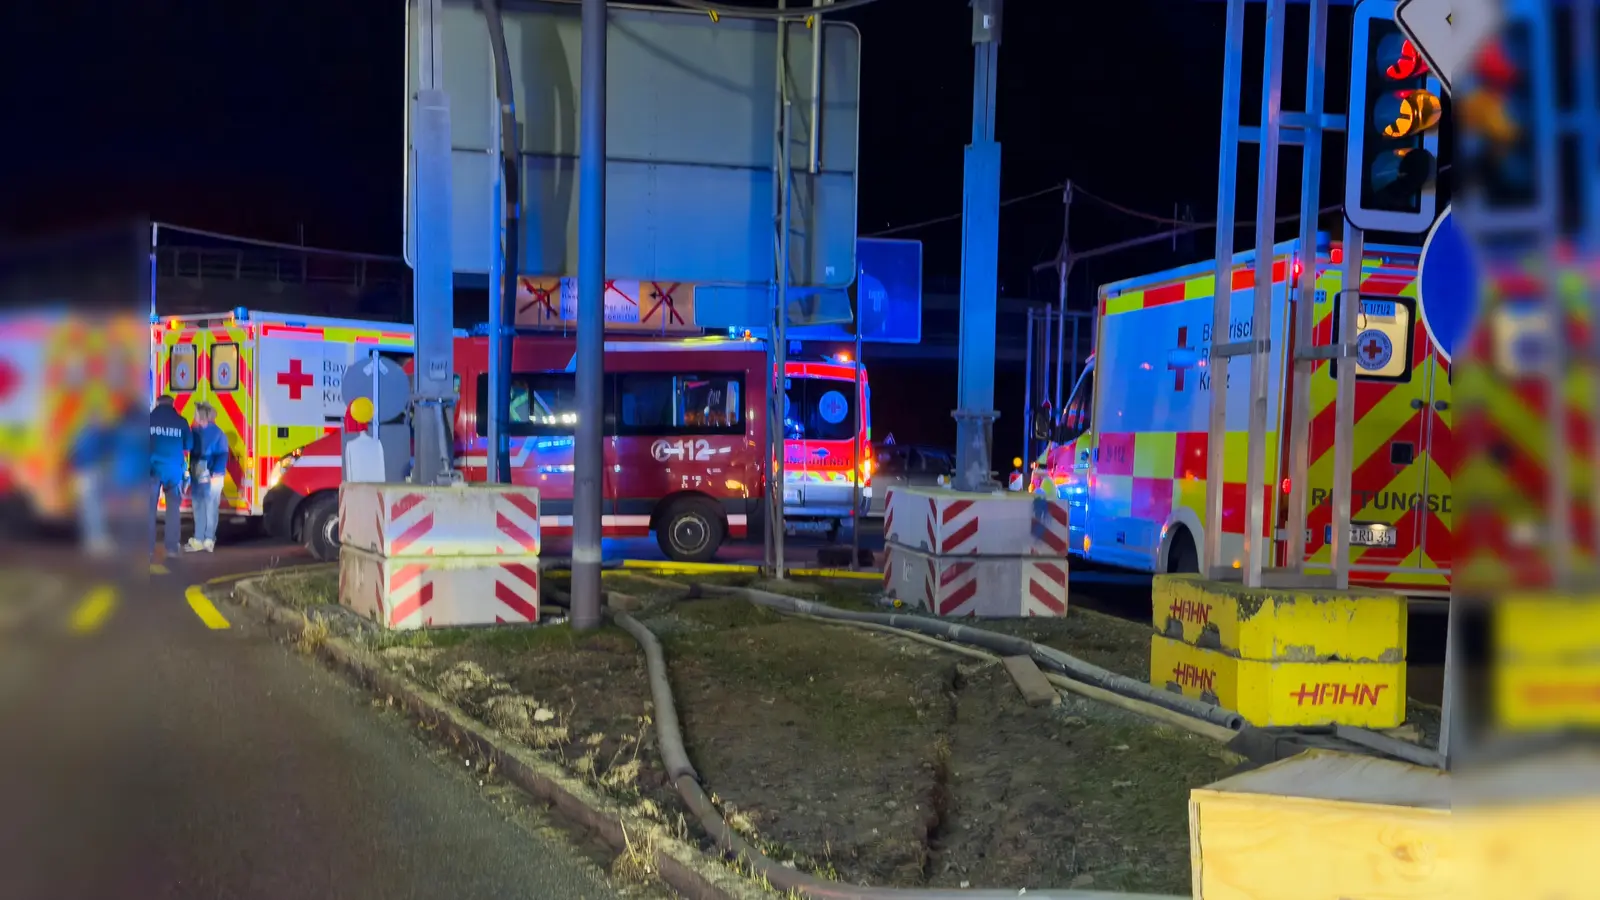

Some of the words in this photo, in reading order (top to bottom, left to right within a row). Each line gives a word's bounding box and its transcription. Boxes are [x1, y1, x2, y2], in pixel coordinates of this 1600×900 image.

[150, 426, 182, 438] POLIZEI
[673, 439, 710, 461] 112
[1311, 487, 1452, 513] RTUNGSD
[1170, 597, 1212, 626] HAHN
[1173, 661, 1216, 690] HAHN
[1289, 682, 1389, 706] HAHN
